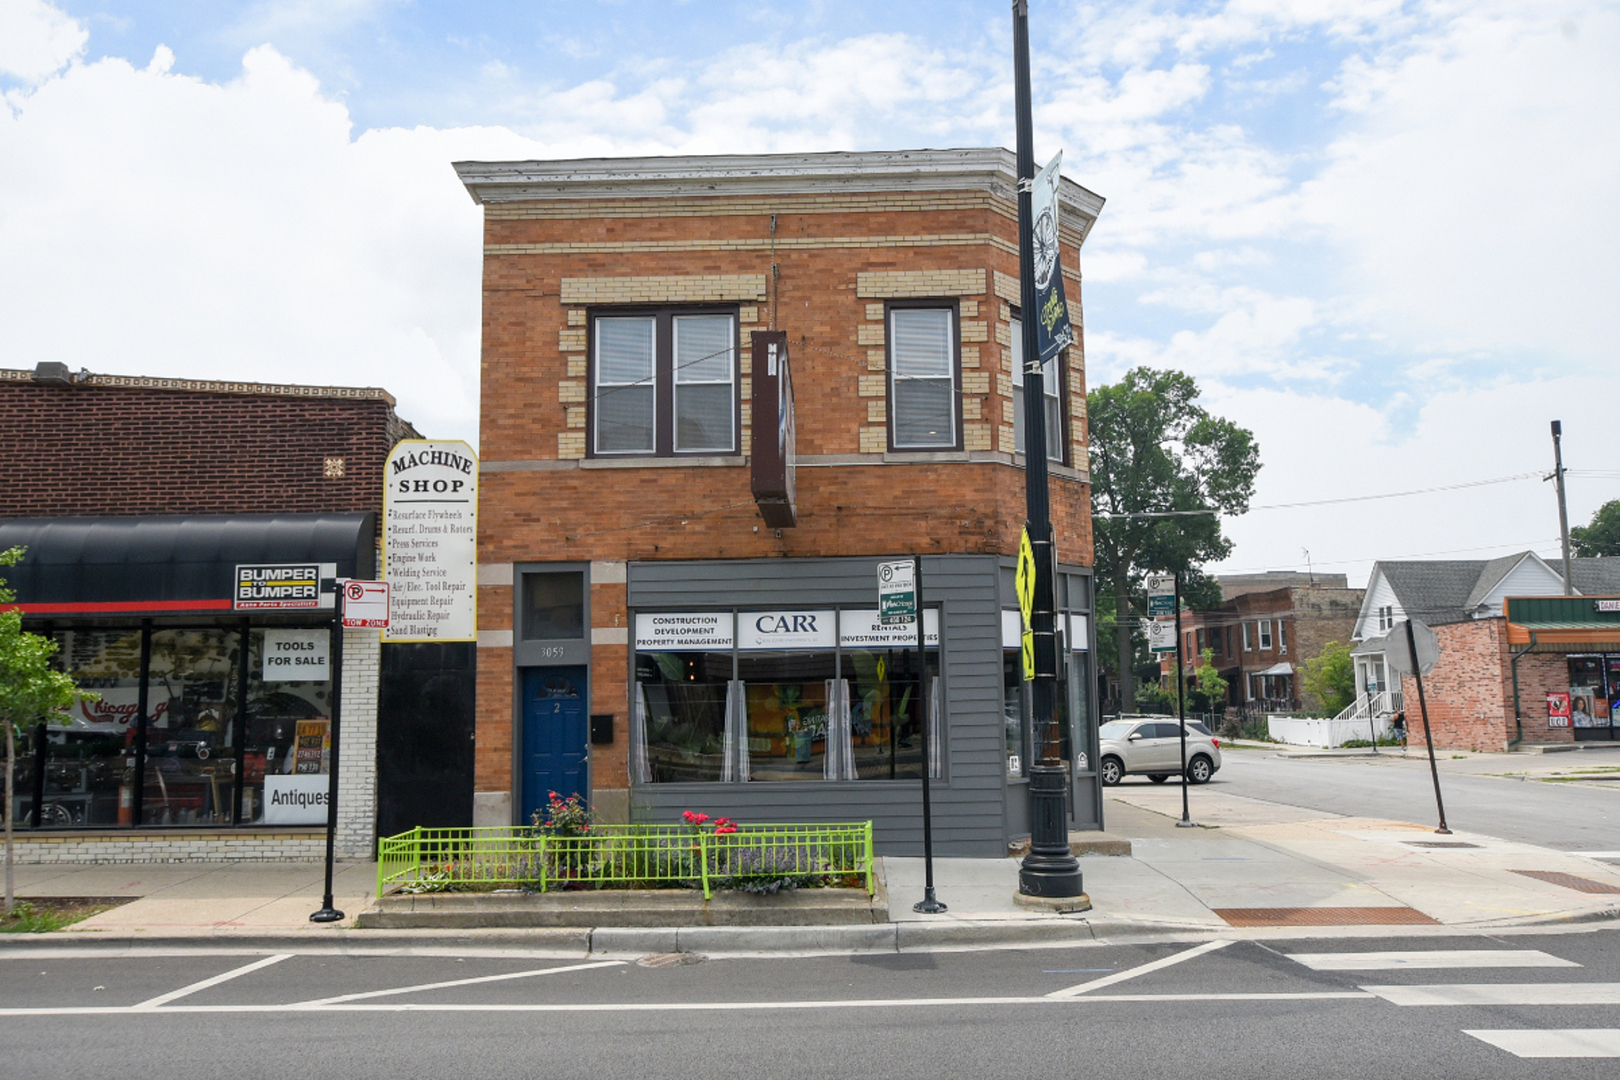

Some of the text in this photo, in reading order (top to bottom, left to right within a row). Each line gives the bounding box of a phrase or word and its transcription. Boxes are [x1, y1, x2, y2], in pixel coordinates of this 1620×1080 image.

[391, 450, 473, 476] MACHINE
[398, 480, 464, 493] SHOP
[392, 510, 463, 525] Resurface Flywheels
[419, 524, 442, 534] Drums
[443, 525, 449, 533] &
[450, 524, 473, 534] Rotors
[392, 538, 439, 549] Press Services
[392, 553, 437, 565] Engine Work
[240, 568, 316, 580] BUMPER
[392, 567, 447, 580] Welding Service
[240, 586, 316, 598] BUMPER
[425, 581, 441, 591] Tool
[442, 581, 466, 594] Repair
[391, 595, 454, 608] Equipment Repair
[365, 619, 386, 627] ZONE
[391, 610, 451, 624] Hydraulic Repair
[652, 617, 718, 625] CONSTRUCTION
[390, 624, 438, 636] Sand Blasting
[755, 615, 818, 634] CARR
[654, 627, 715, 635] DEVELOPMENT
[892, 634, 938, 642] PROPETIES
[275, 642, 315, 651] TOOLS
[540, 647, 564, 659] 3059
[268, 656, 325, 666] FOR SALE
[553, 703, 560, 713] 2
[271, 789, 330, 809] Antiques
